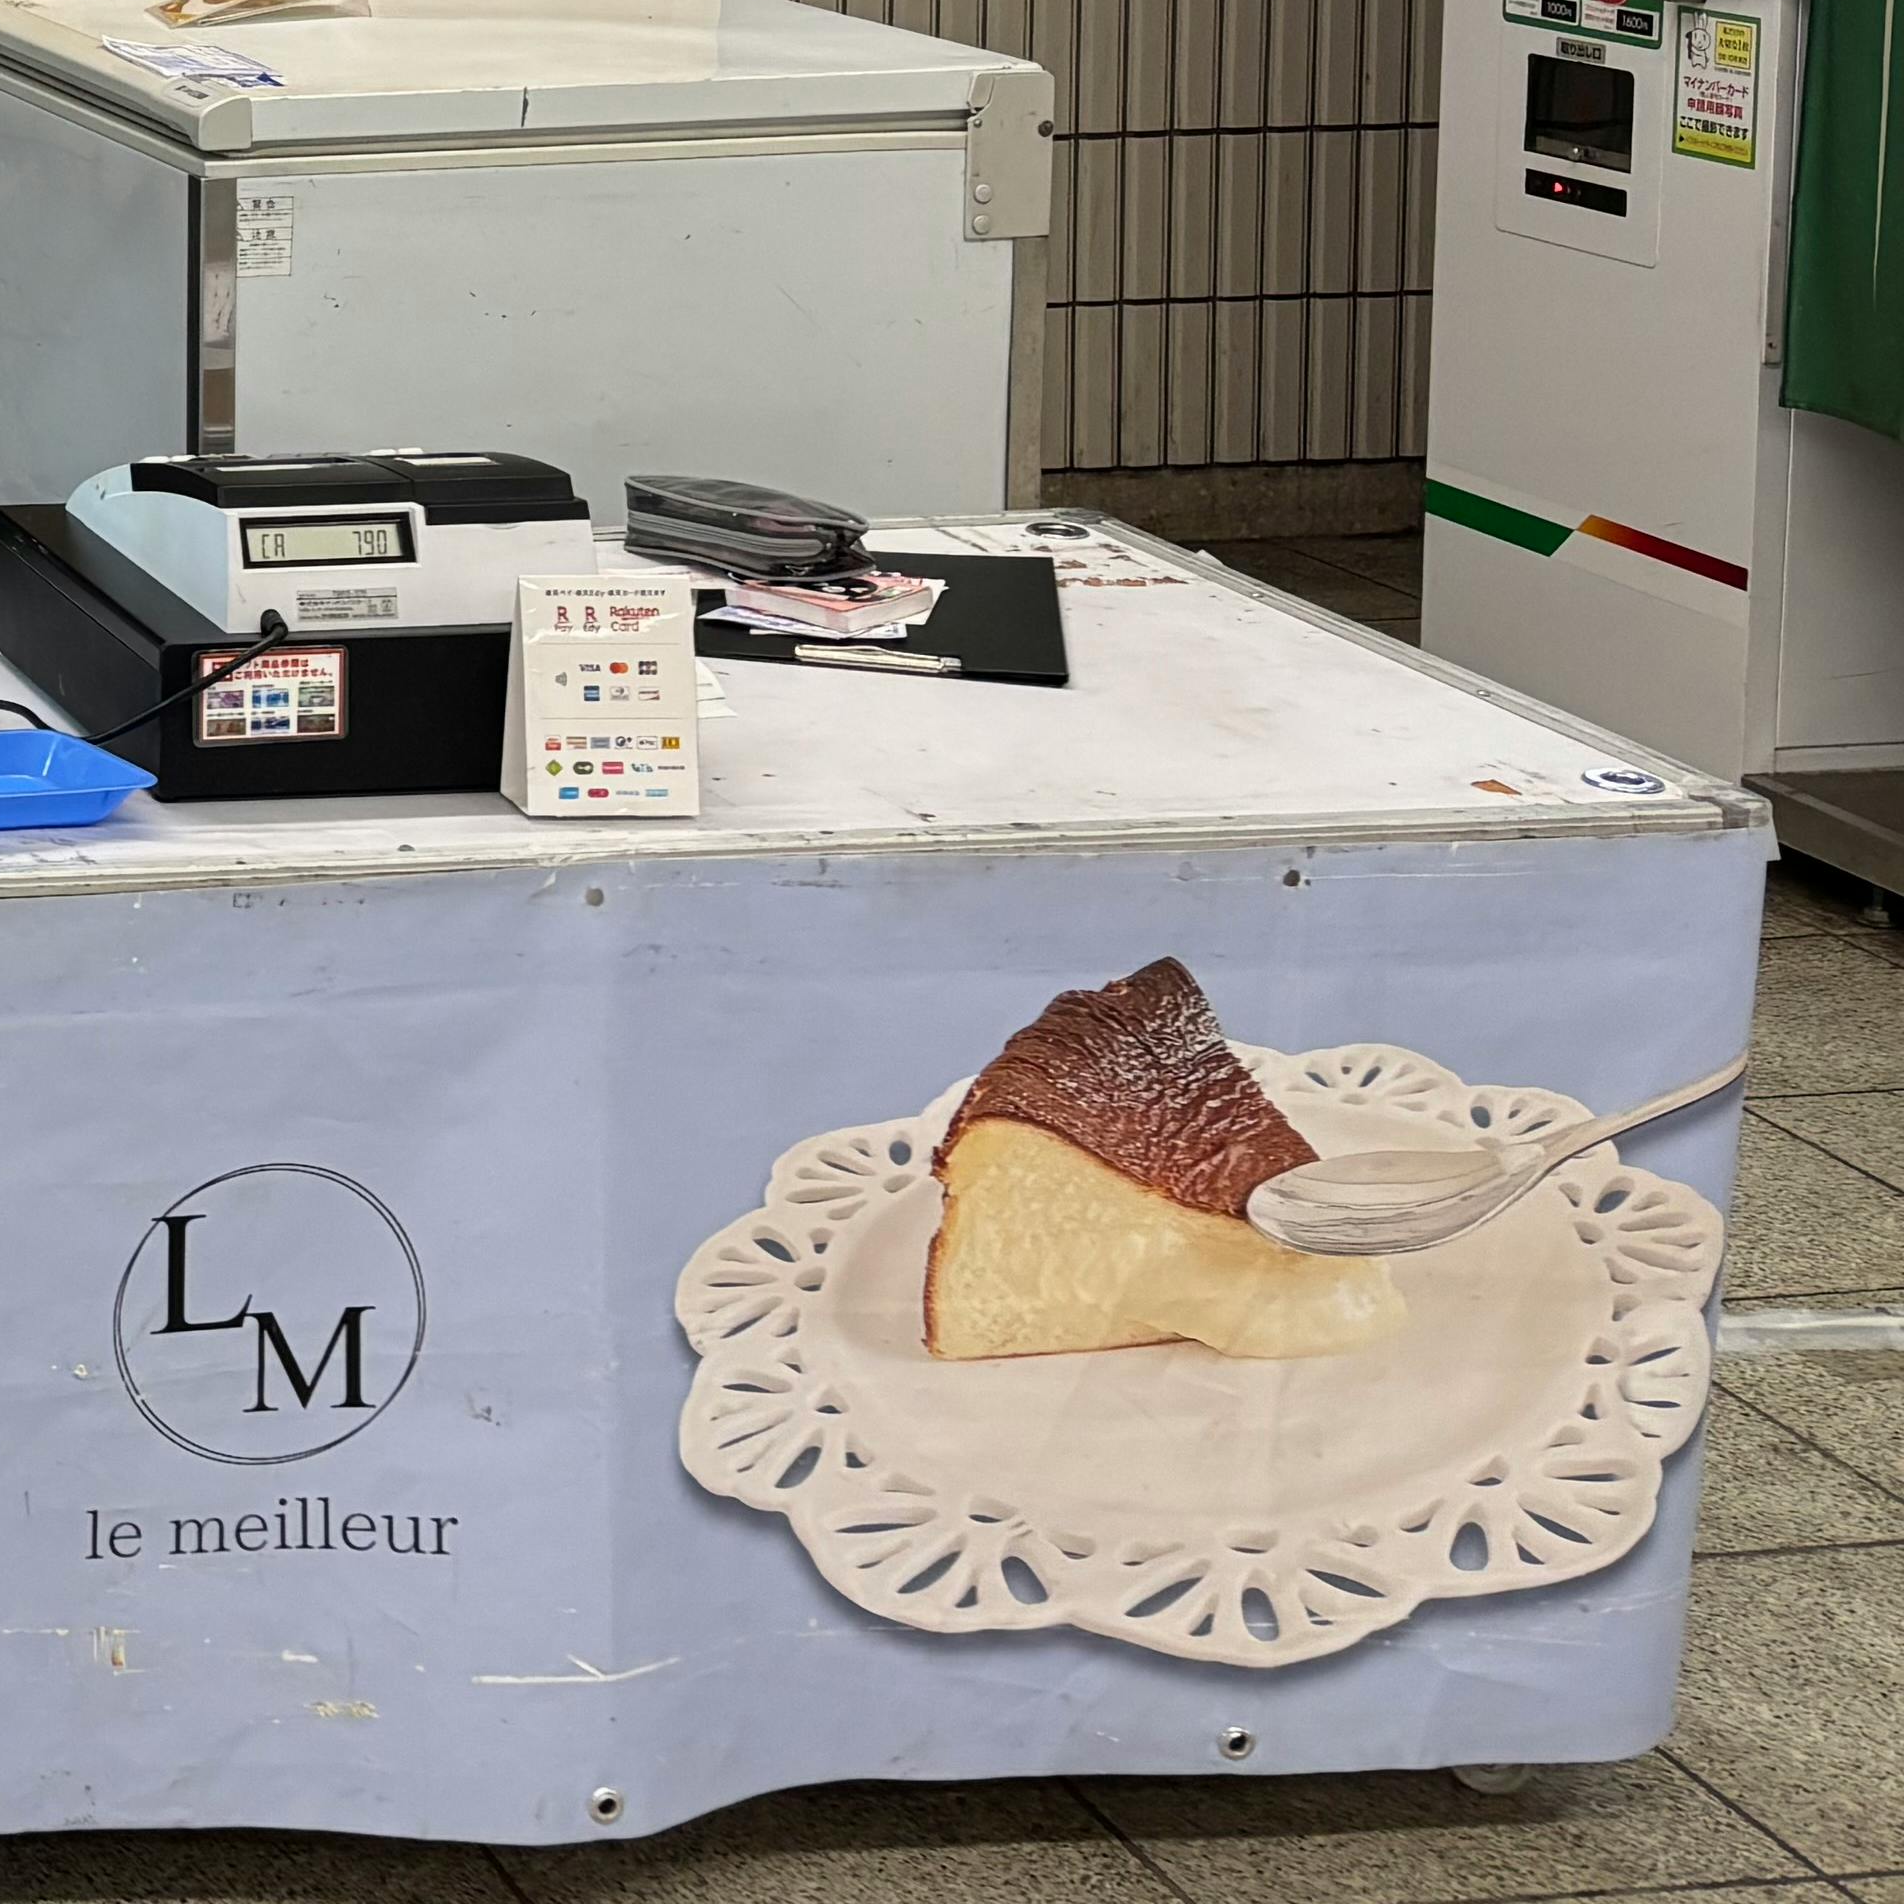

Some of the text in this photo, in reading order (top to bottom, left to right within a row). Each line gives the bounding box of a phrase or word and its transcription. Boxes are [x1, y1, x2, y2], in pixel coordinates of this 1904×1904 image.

[1561, 42, 1602, 62] 取り出し口
[1683, 75, 1749, 99] マイナンバーカード
[1679, 115, 1749, 141] ここで撮影できます
[352, 530, 388, 556] 790
[557, 606, 660, 622] R R Rakuten
[610, 621, 640, 632] Card
[150, 1214, 377, 1413] LM
[84, 1496, 459, 1560] le meilleur
